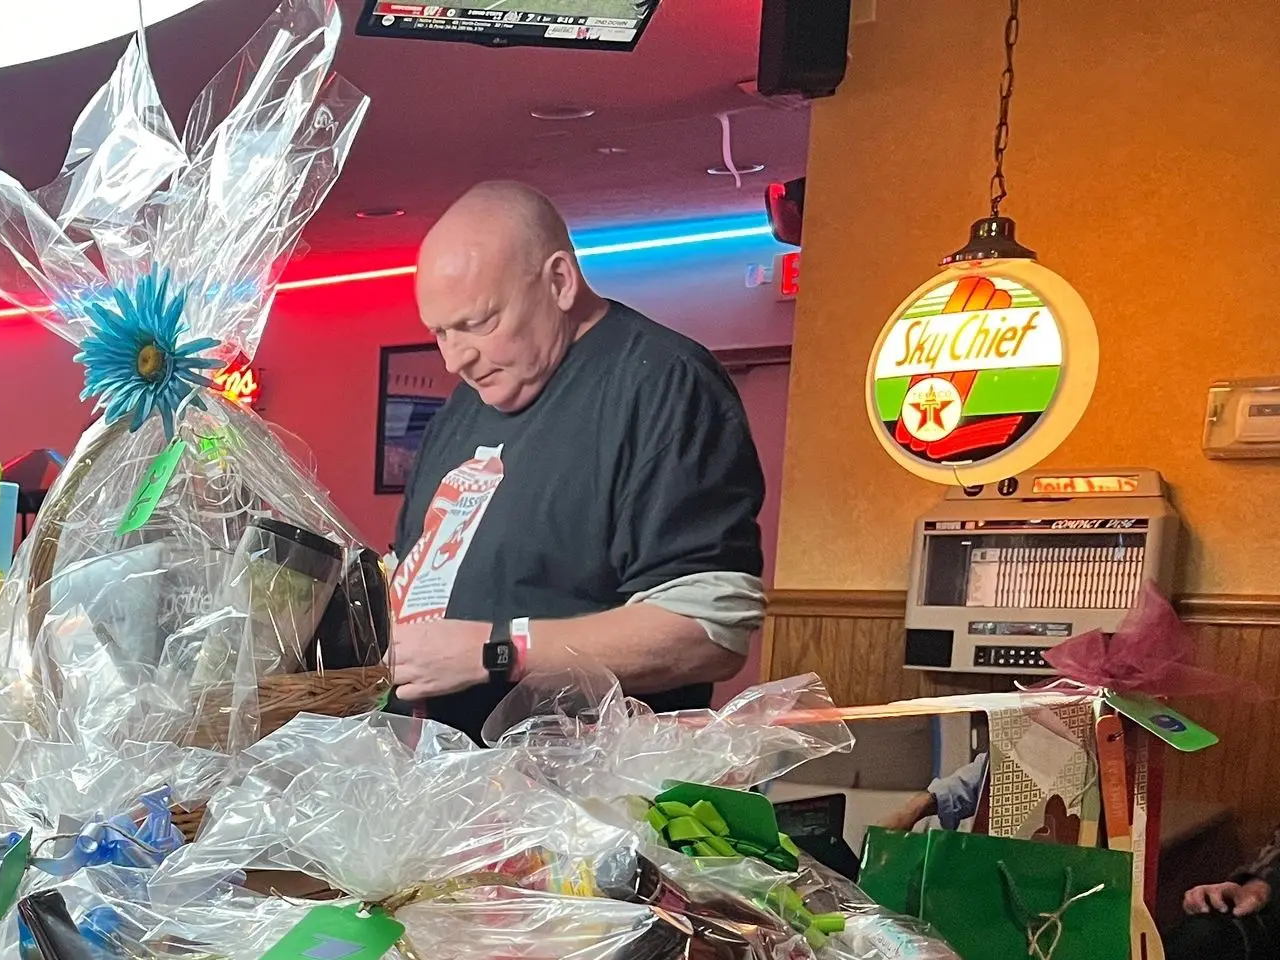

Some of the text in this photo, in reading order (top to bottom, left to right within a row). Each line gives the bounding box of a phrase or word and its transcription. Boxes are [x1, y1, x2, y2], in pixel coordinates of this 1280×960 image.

[895, 311, 1041, 369] Sky Chief
[1051, 518, 1137, 530] COMPACT DISC
